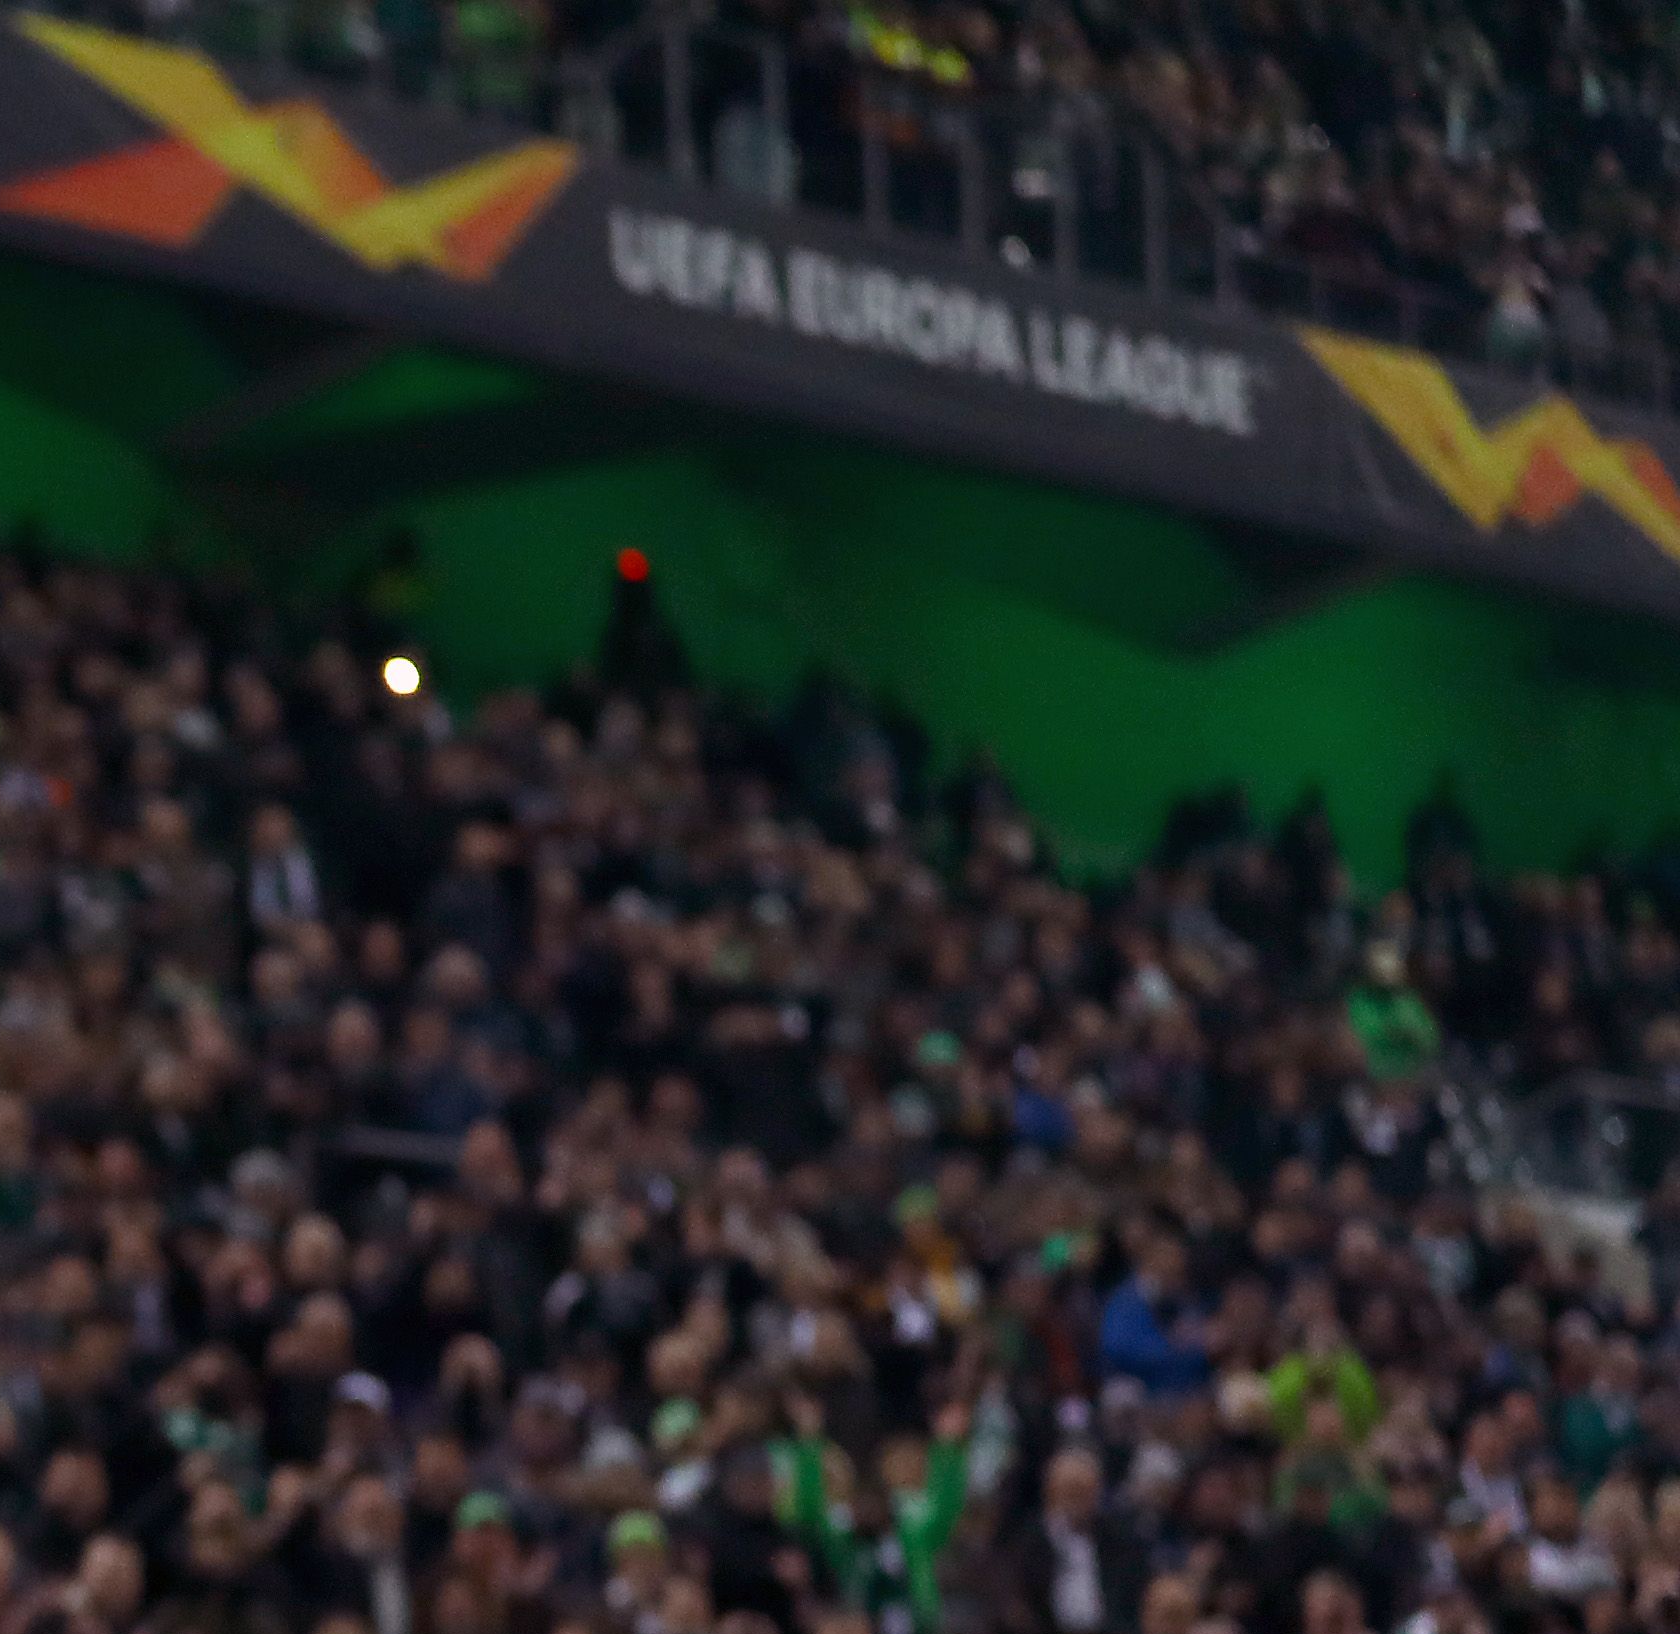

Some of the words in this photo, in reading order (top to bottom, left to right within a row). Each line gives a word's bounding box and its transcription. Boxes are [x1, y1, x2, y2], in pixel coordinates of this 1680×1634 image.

[608, 205, 778, 324] UEFA
[785, 245, 1028, 382] EUROPA
[1031, 308, 1255, 437] LEAGUE
